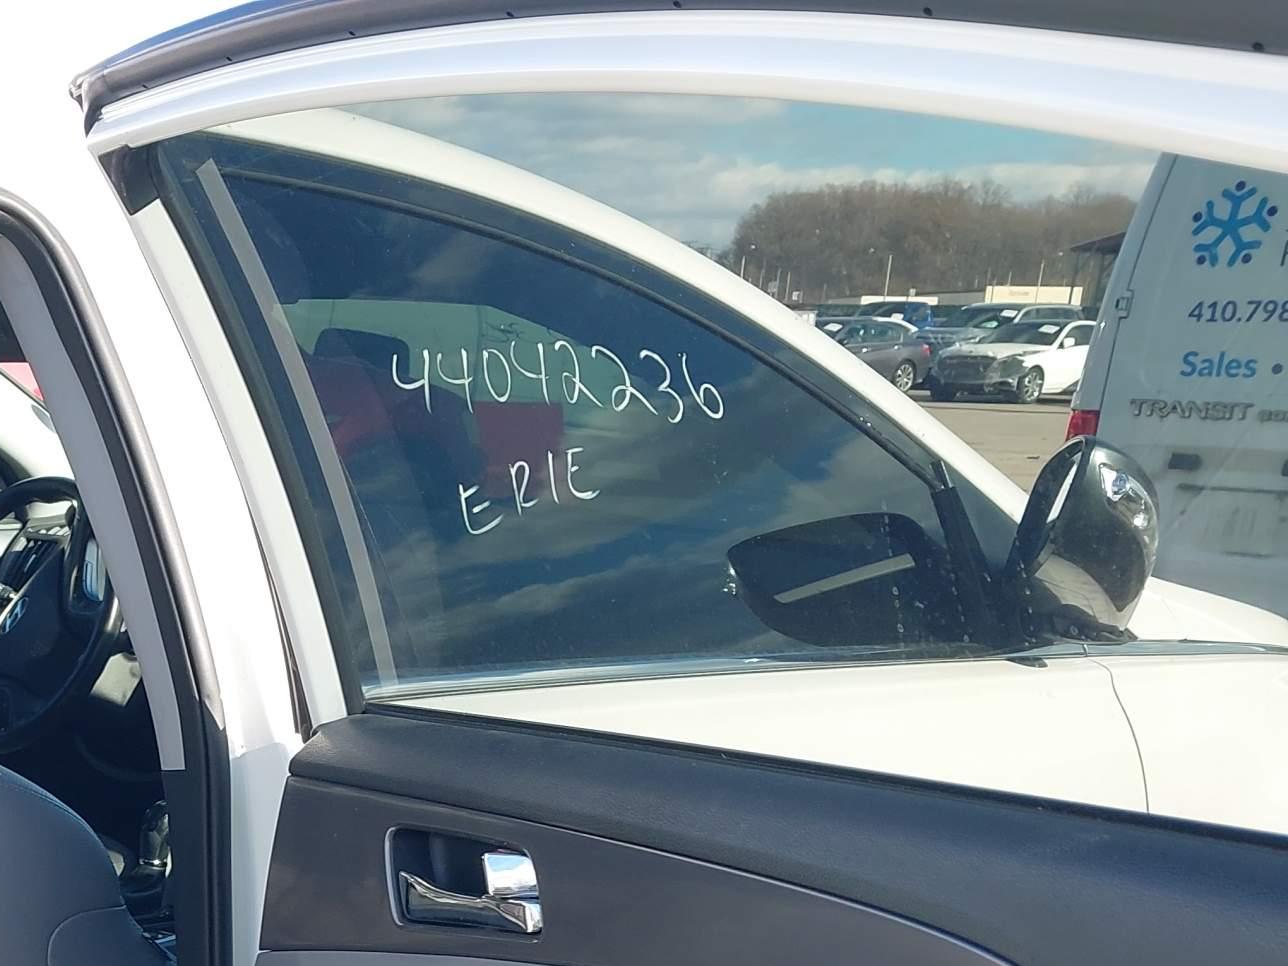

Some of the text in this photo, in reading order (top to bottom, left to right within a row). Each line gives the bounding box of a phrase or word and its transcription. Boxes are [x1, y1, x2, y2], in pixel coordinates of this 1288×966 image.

[391, 340, 725, 424] 44042236
[1180, 350, 1258, 379] Sales
[1129, 398, 1256, 421] TRANSIT
[458, 446, 601, 536] ERIE
